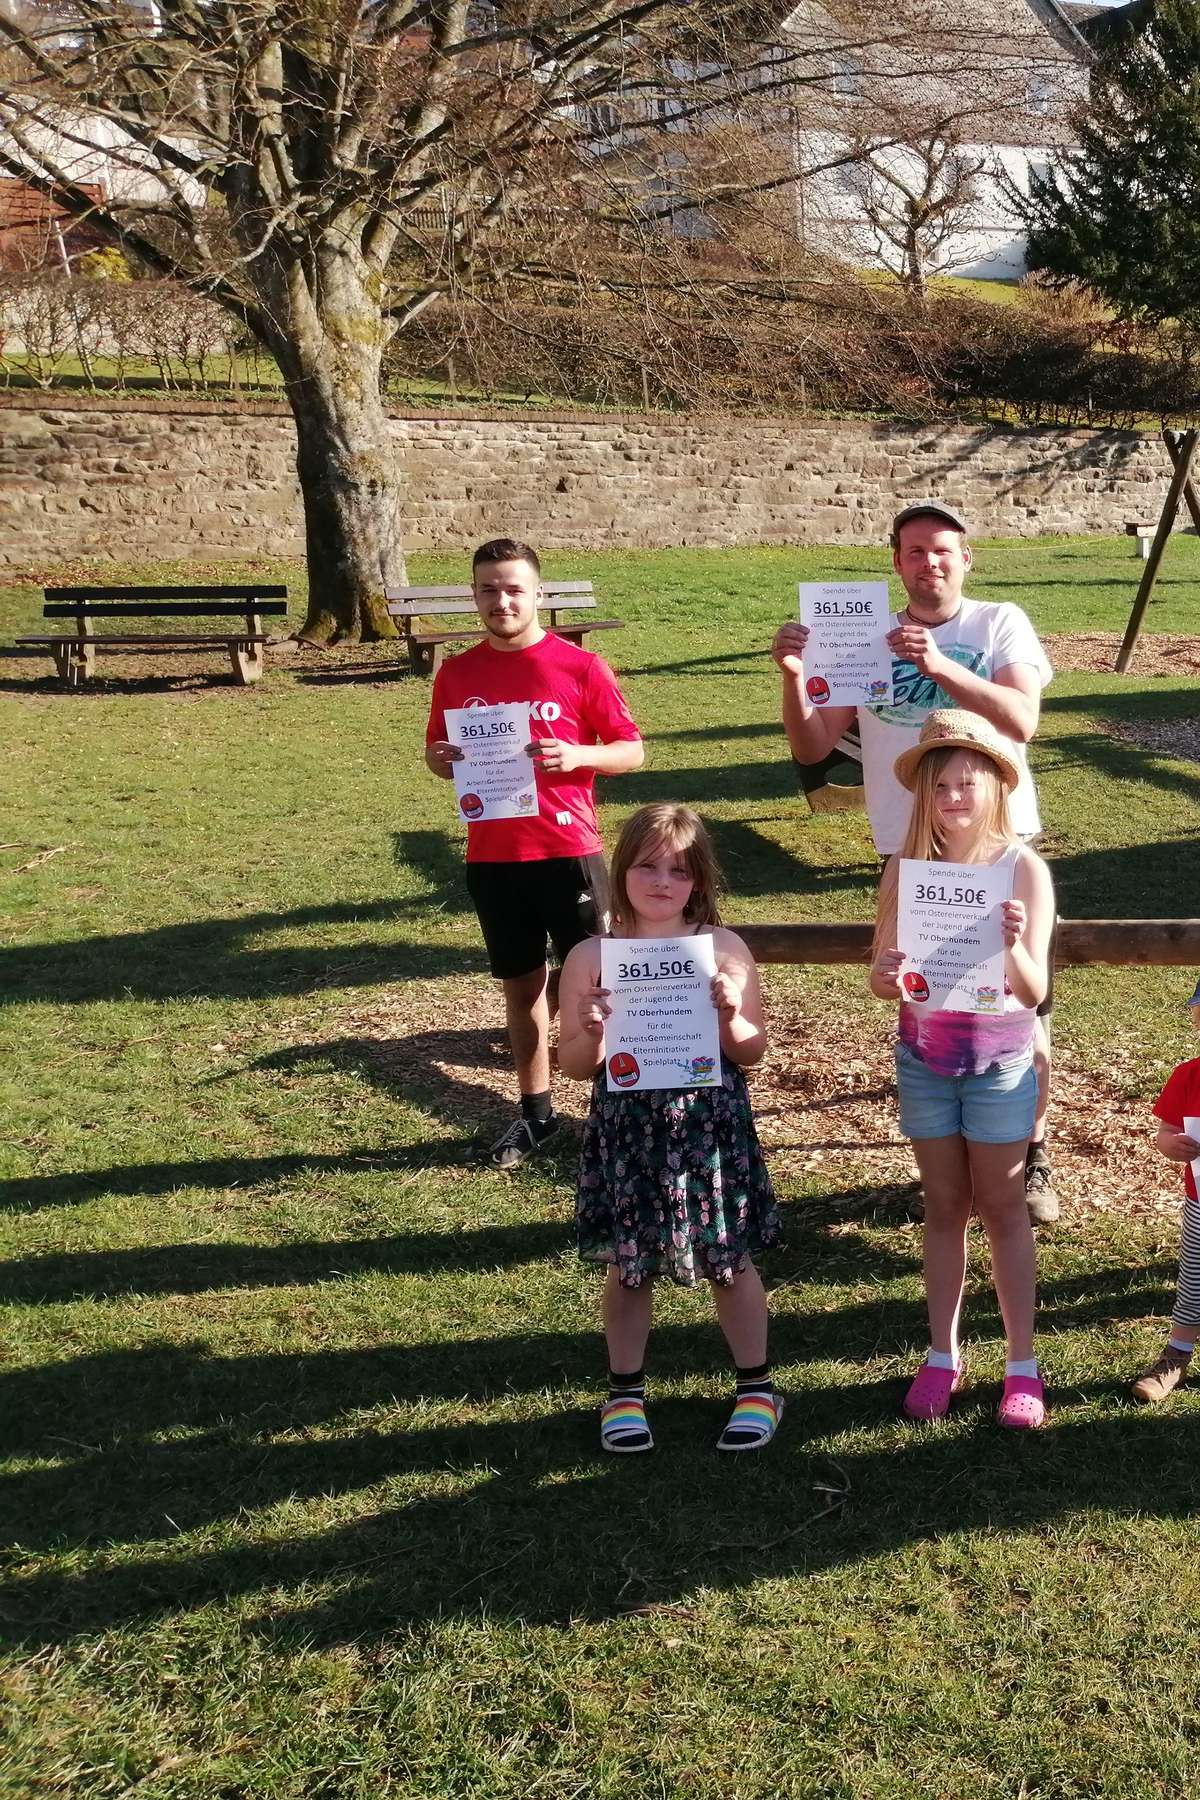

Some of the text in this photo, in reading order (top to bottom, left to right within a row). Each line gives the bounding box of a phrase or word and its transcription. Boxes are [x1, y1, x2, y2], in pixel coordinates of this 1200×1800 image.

[813, 601, 873, 617] 361,50€
[460, 721, 516, 738] 361,50€
[928, 868, 976, 879] Spende über
[915, 884, 986, 905] 361,50€
[927, 909, 990, 921] Ostereierverkauf
[936, 922, 962, 932] Jugend
[964, 924, 977, 932] des
[918, 933, 980, 945] TV Oberhundem
[629, 945, 679, 954] Spende über
[911, 957, 988, 970] ArbeitsGemeinschaft
[618, 960, 695, 980] 361,50€
[614, 982, 701, 995] vom Ostereierverkauf
[932, 981, 967, 991] Spielplatz
[645, 995, 672, 1005] Jugend
[674, 994, 689, 1002] des
[639, 1008, 692, 1016] Oberhundem
[619, 1032, 702, 1043] ArbeitsGemeinschaft
[643, 1058, 681, 1067] Spielplatz
